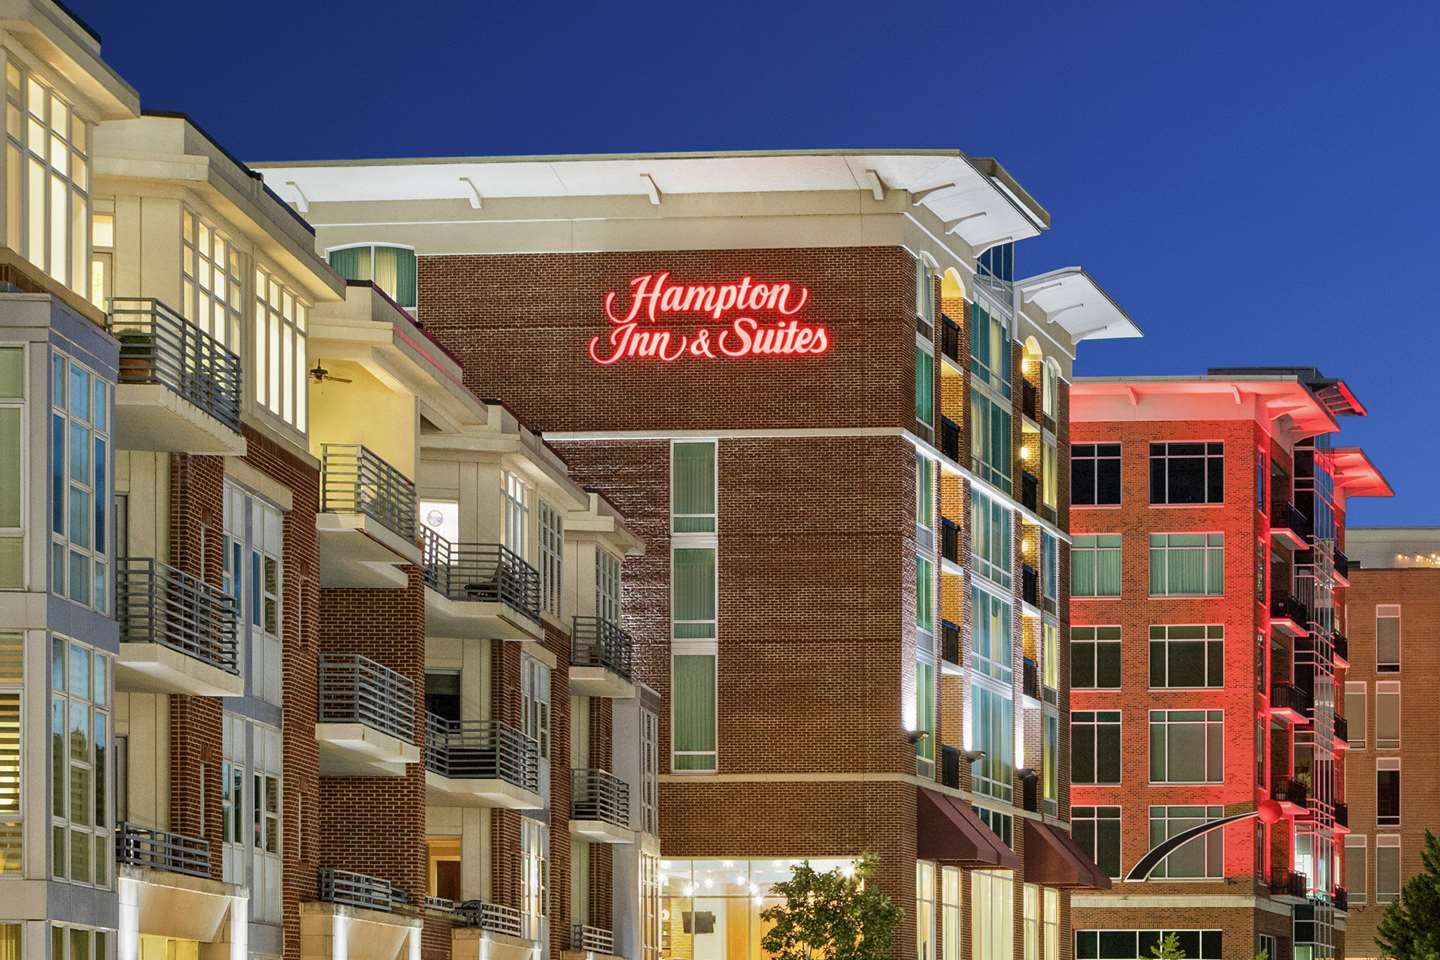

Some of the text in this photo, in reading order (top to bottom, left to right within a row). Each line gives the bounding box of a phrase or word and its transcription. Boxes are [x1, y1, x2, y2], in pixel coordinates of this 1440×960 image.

[606, 271, 808, 323] Hampton
[590, 317, 828, 365] Inn & Suites
